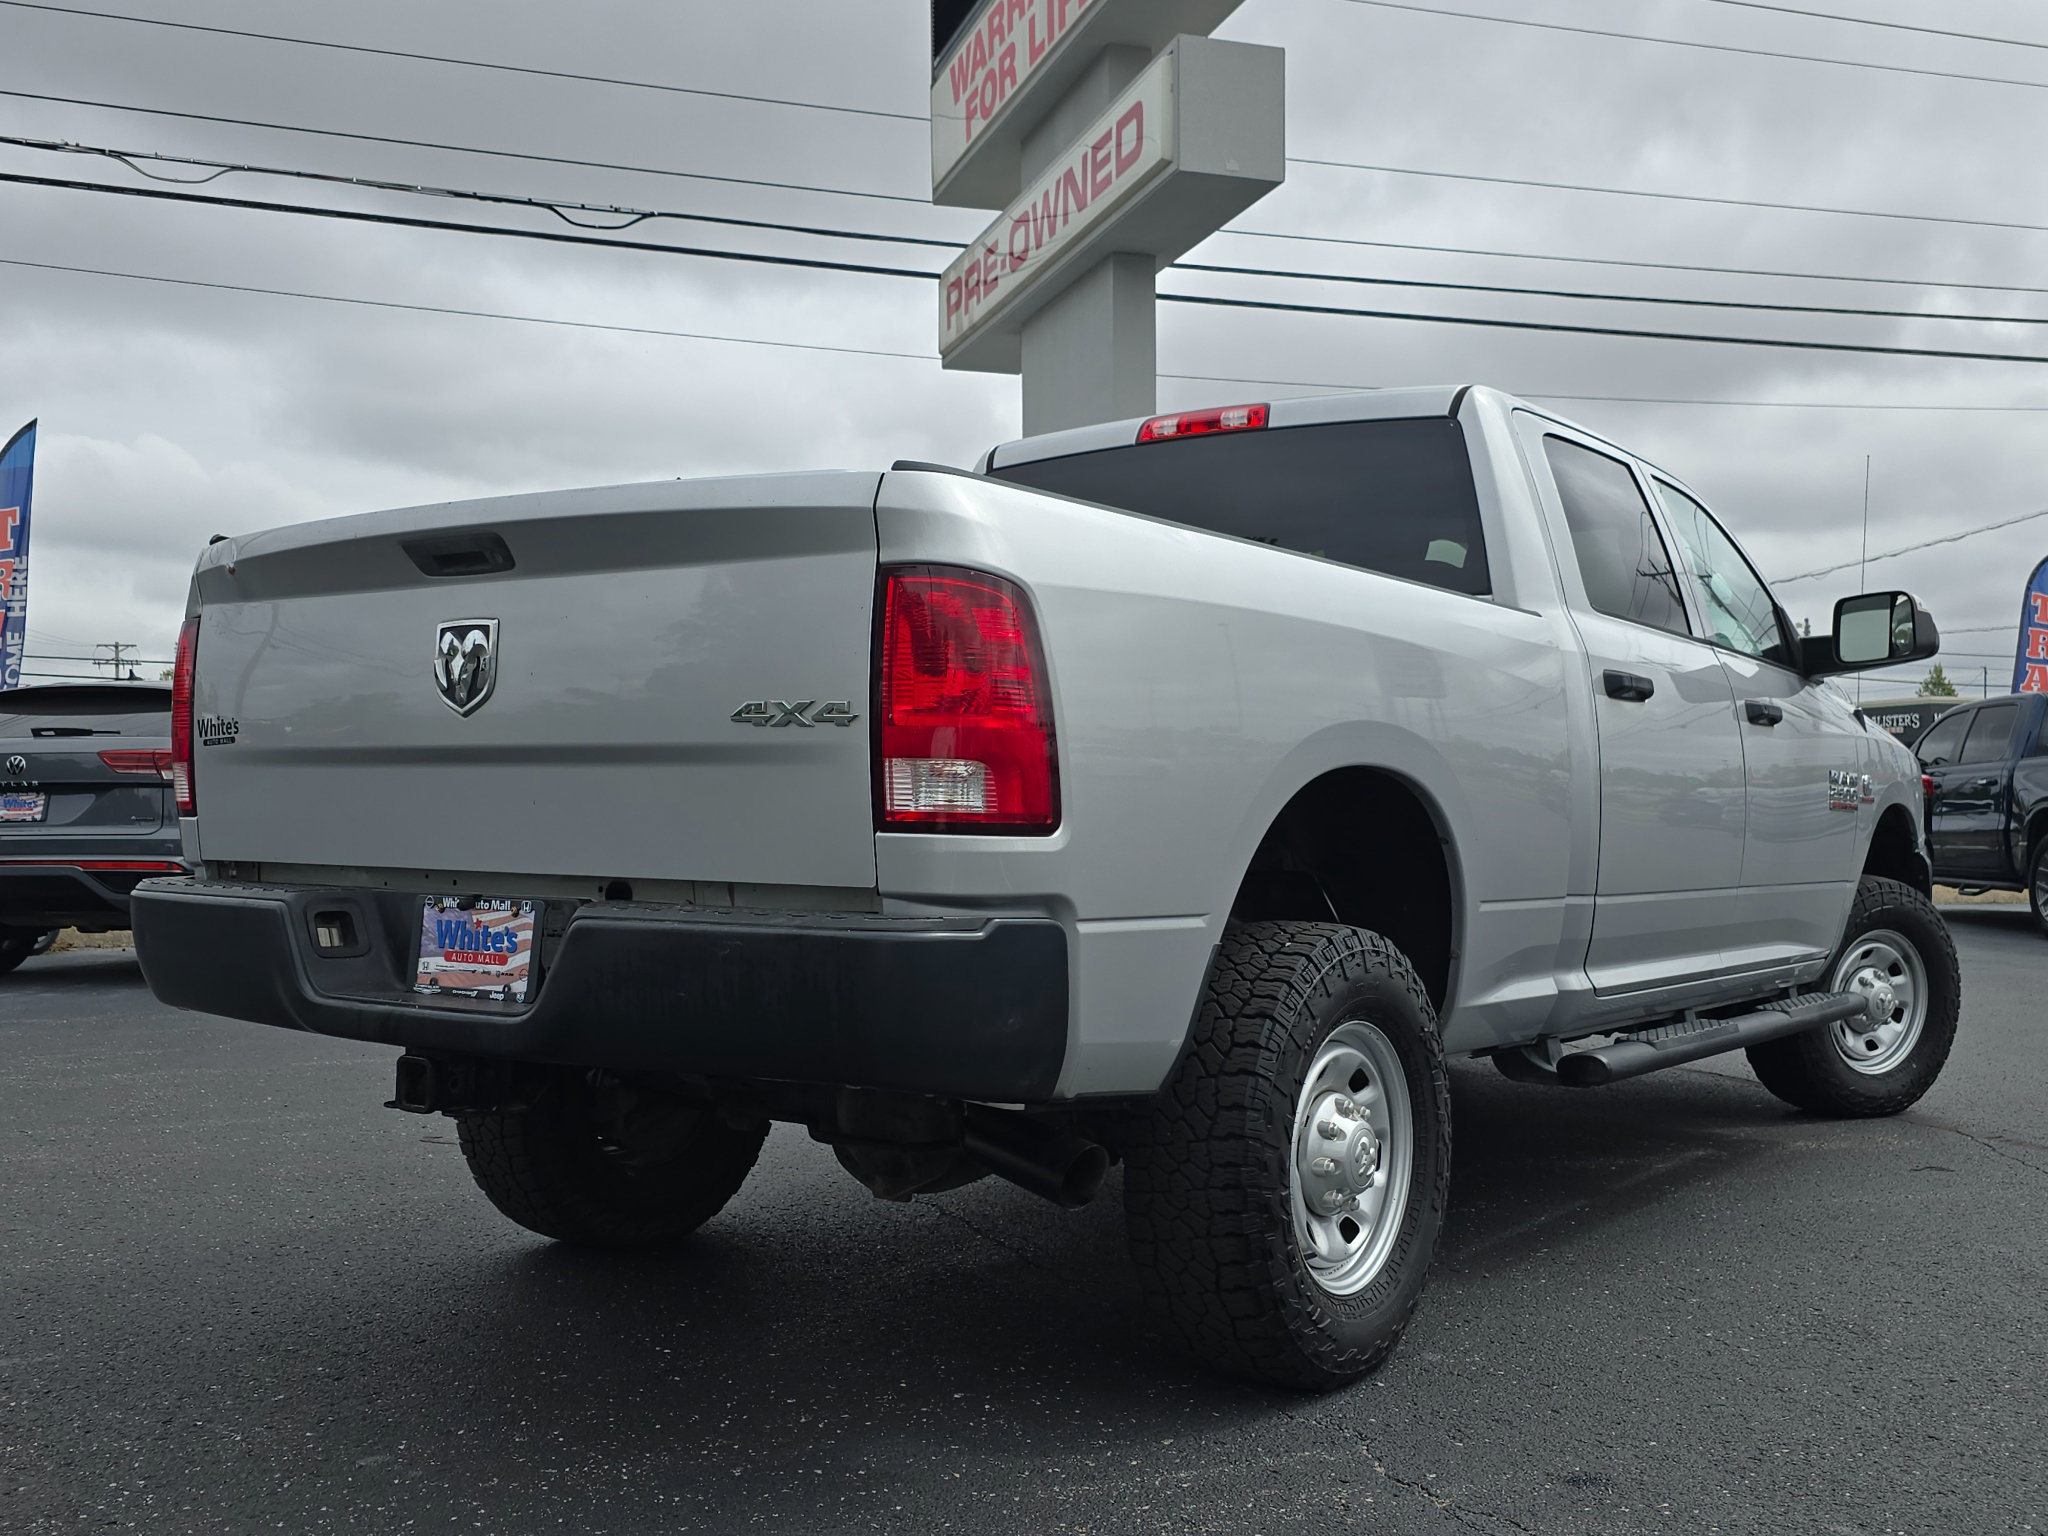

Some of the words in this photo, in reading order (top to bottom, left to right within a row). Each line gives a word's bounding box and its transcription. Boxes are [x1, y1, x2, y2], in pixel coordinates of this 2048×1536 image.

[950, 0, 1034, 106] WARR
[965, 41, 1017, 144] FOR
[1028, 0, 1088, 67] LIF
[6, 555, 28, 617] HERE
[4, 630, 24, 690] OME
[197, 715, 239, 738] White's
[730, 699, 859, 728] 4X4
[475, 900, 490, 911] uto
[491, 900, 511, 911] Mall
[437, 919, 518, 954] White's
[451, 952, 474, 963] AUTO
[477, 955, 500, 965] MALL
